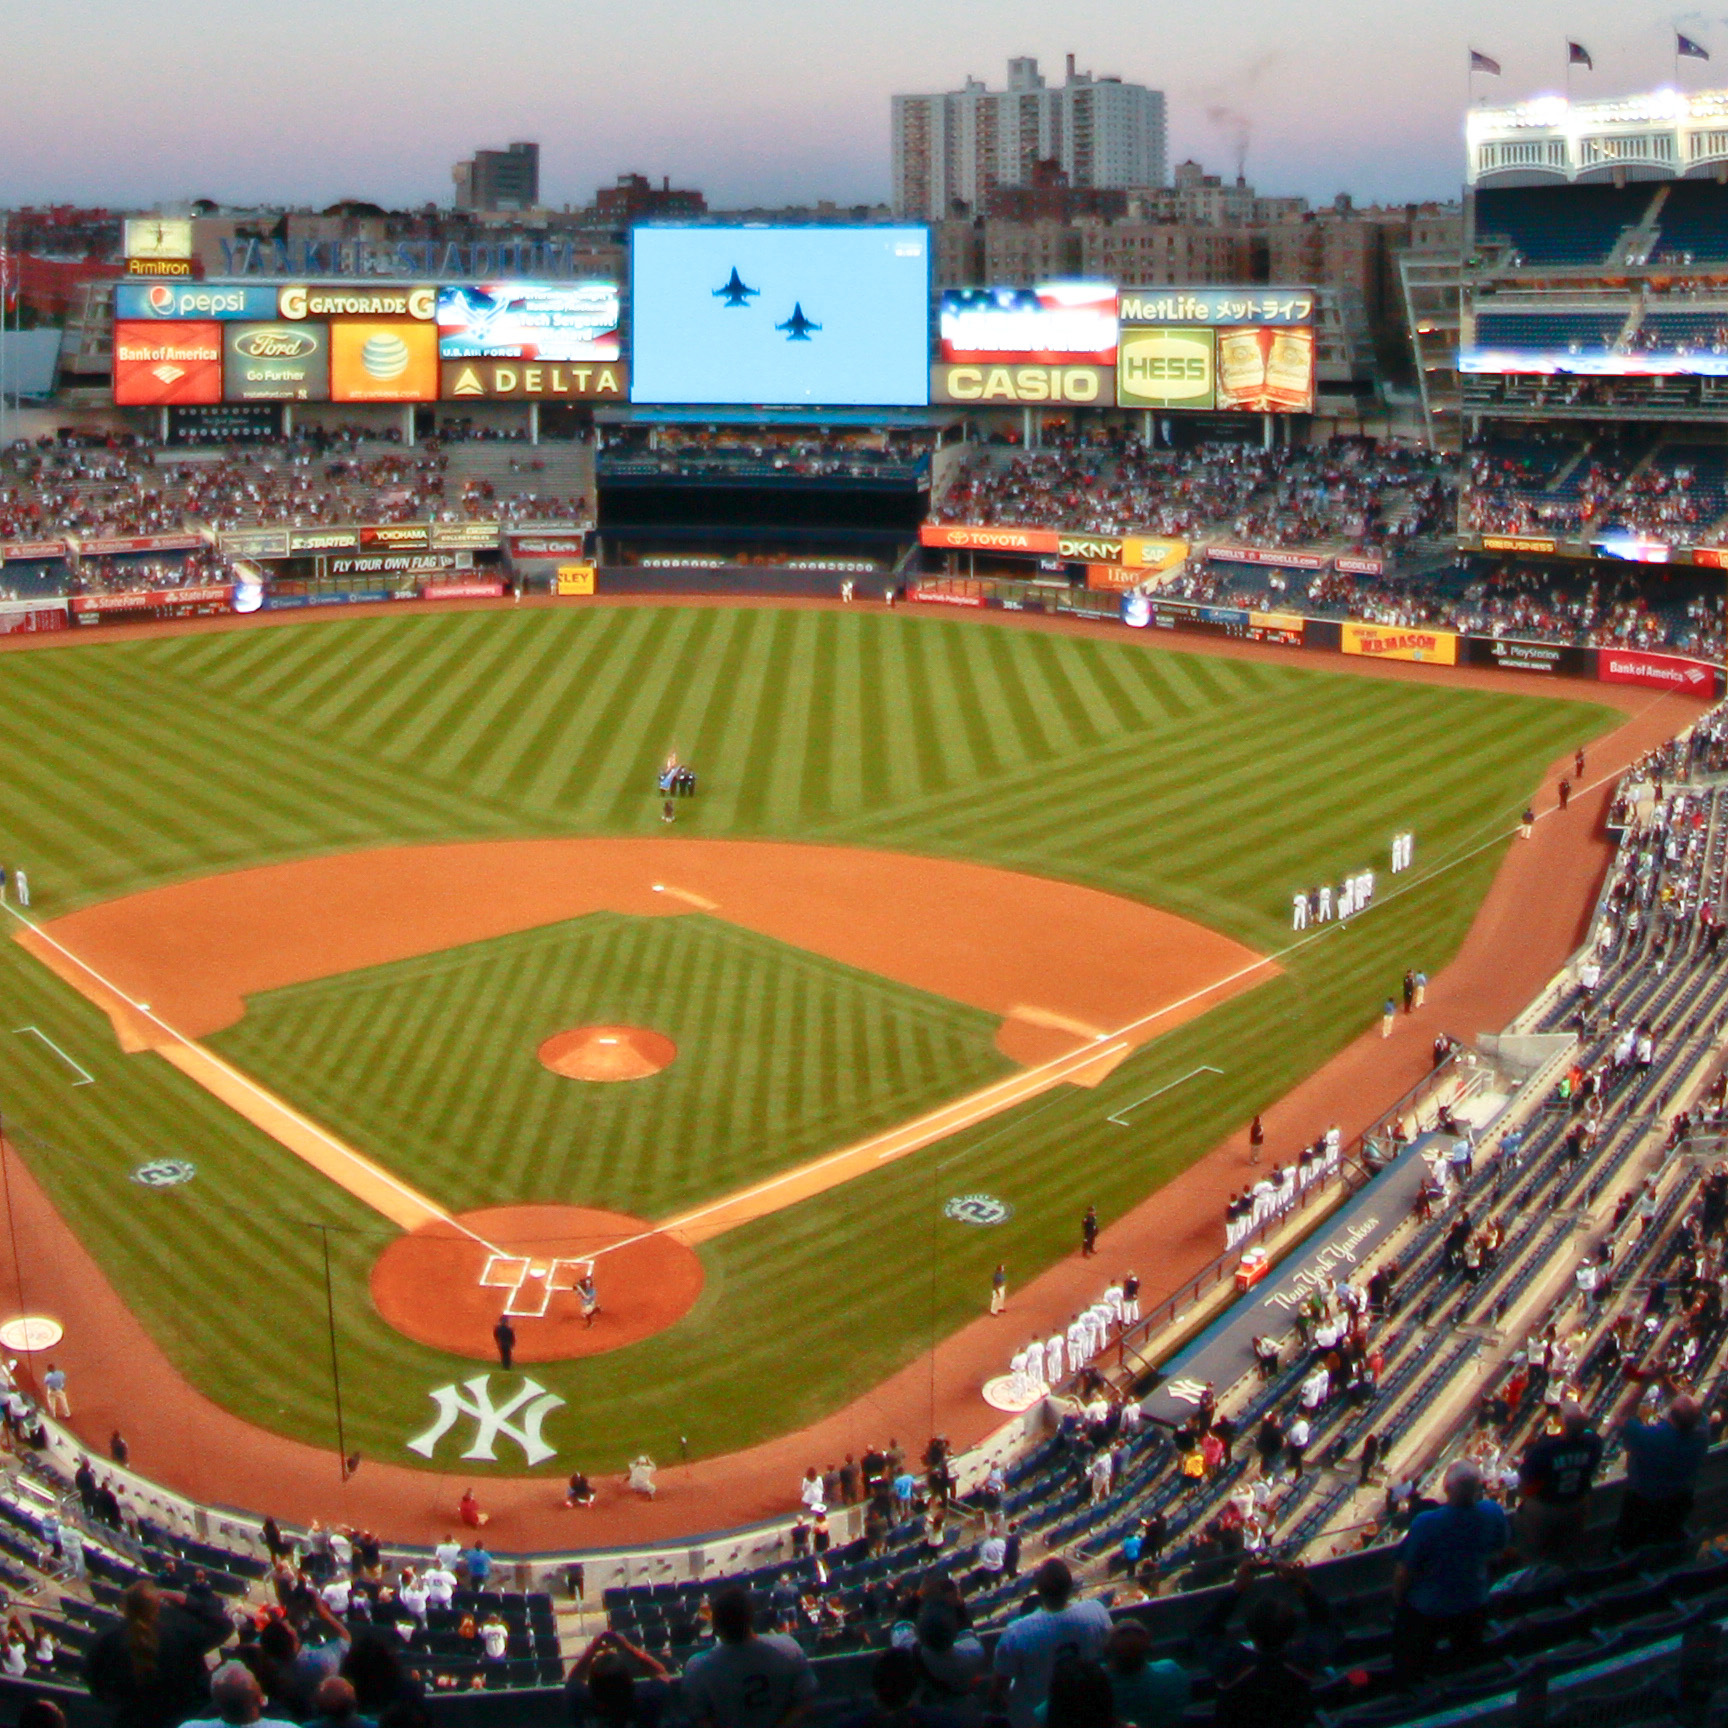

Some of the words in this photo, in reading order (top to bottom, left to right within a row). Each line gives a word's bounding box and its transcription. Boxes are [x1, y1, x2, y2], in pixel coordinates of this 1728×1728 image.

[219, 237, 370, 274] YANKEE
[396, 237, 574, 274] STADIUM
[129, 259, 190, 275] Armitron
[179, 290, 245, 315] pepsi
[280, 287, 308, 320] G
[309, 296, 407, 315] GATORADE
[408, 287, 437, 320] G
[1120, 296, 1210, 321] MetLife
[1216, 299, 1313, 321] メットライフ
[119, 347, 152, 361] Bank
[152, 347, 166, 361] of
[166, 347, 218, 361] America
[249, 334, 302, 357] Ford
[483, 348, 522, 357] FORCE
[246, 370, 263, 382] Go
[263, 369, 305, 381] Further
[1127, 356, 1206, 381] HESS
[495, 369, 619, 393] DELTA
[947, 368, 1099, 402] CASIO
[308, 536, 356, 549] STARTER
[375, 530, 428, 541] YOKOHAMA
[970, 532, 1028, 548] TOYOTA
[1058, 539, 1123, 560] DKNY
[1141, 547, 1166, 562] SAP
[333, 560, 351, 572] FLY
[354, 558, 382, 571] YOUR
[384, 557, 411, 570] OWN
[411, 555, 437, 569] FLAG
[1510, 646, 1560, 661] PlayStation
[1609, 661, 1636, 675] Bank
[1636, 663, 1647, 676] of
[1647, 665, 1684, 683] America
[1264, 1284, 1313, 1311] New
[1292, 1253, 1338, 1288] York
[1321, 1217, 1380, 1263] Yankees
[407, 1373, 567, 1467] NY
